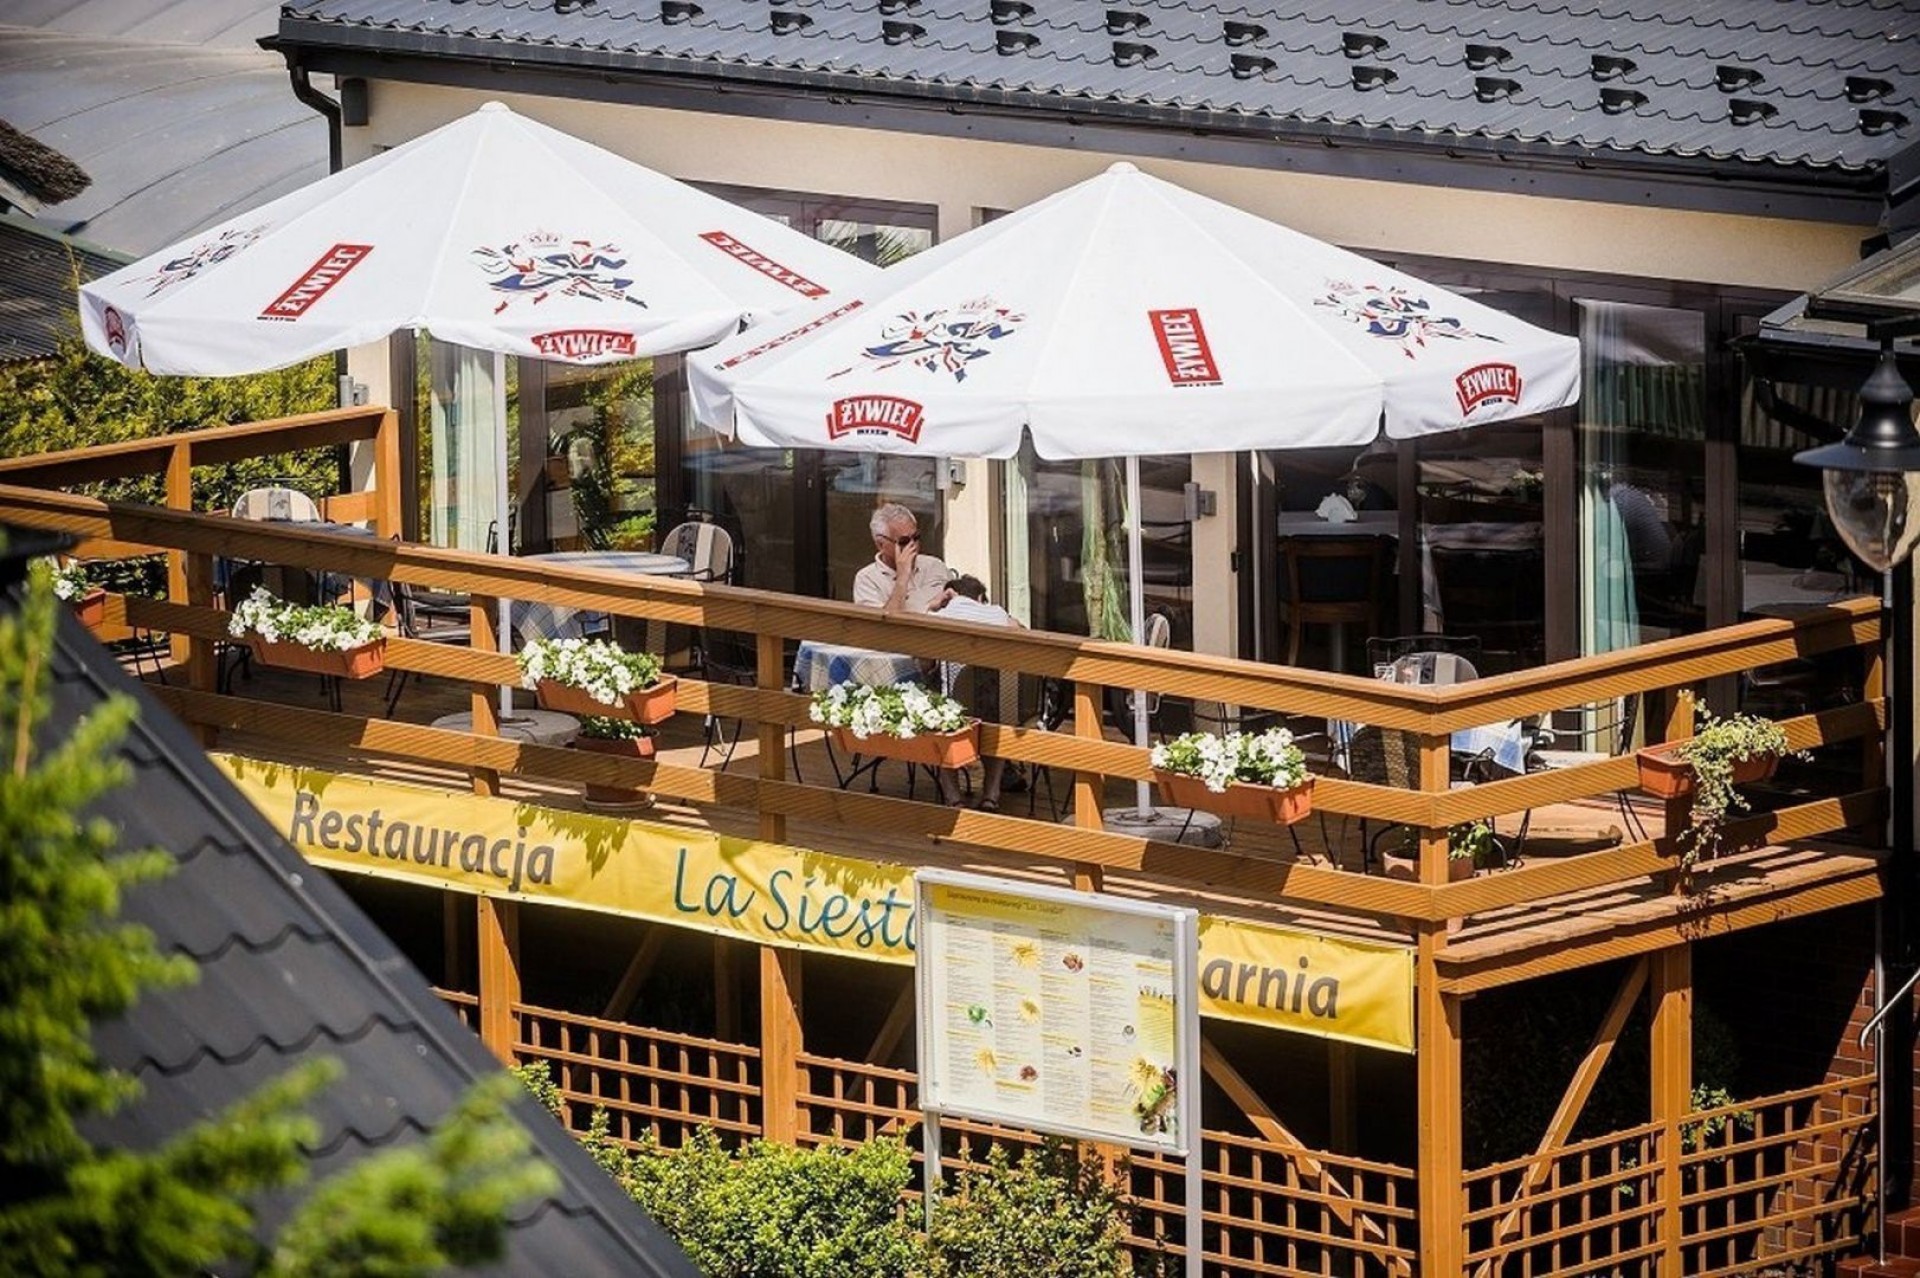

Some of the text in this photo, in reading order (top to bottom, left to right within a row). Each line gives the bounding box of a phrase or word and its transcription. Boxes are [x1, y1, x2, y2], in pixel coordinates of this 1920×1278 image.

[274, 248, 363, 311] ŻYWIEC
[1160, 312, 1211, 379] ŻYWIEC
[841, 399, 916, 428] ŻYWIEC
[1461, 368, 1514, 400] ŻYWIEC
[290, 792, 555, 892] Restauracja
[674, 848, 755, 918] La
[1199, 956, 1340, 1019] arnia
